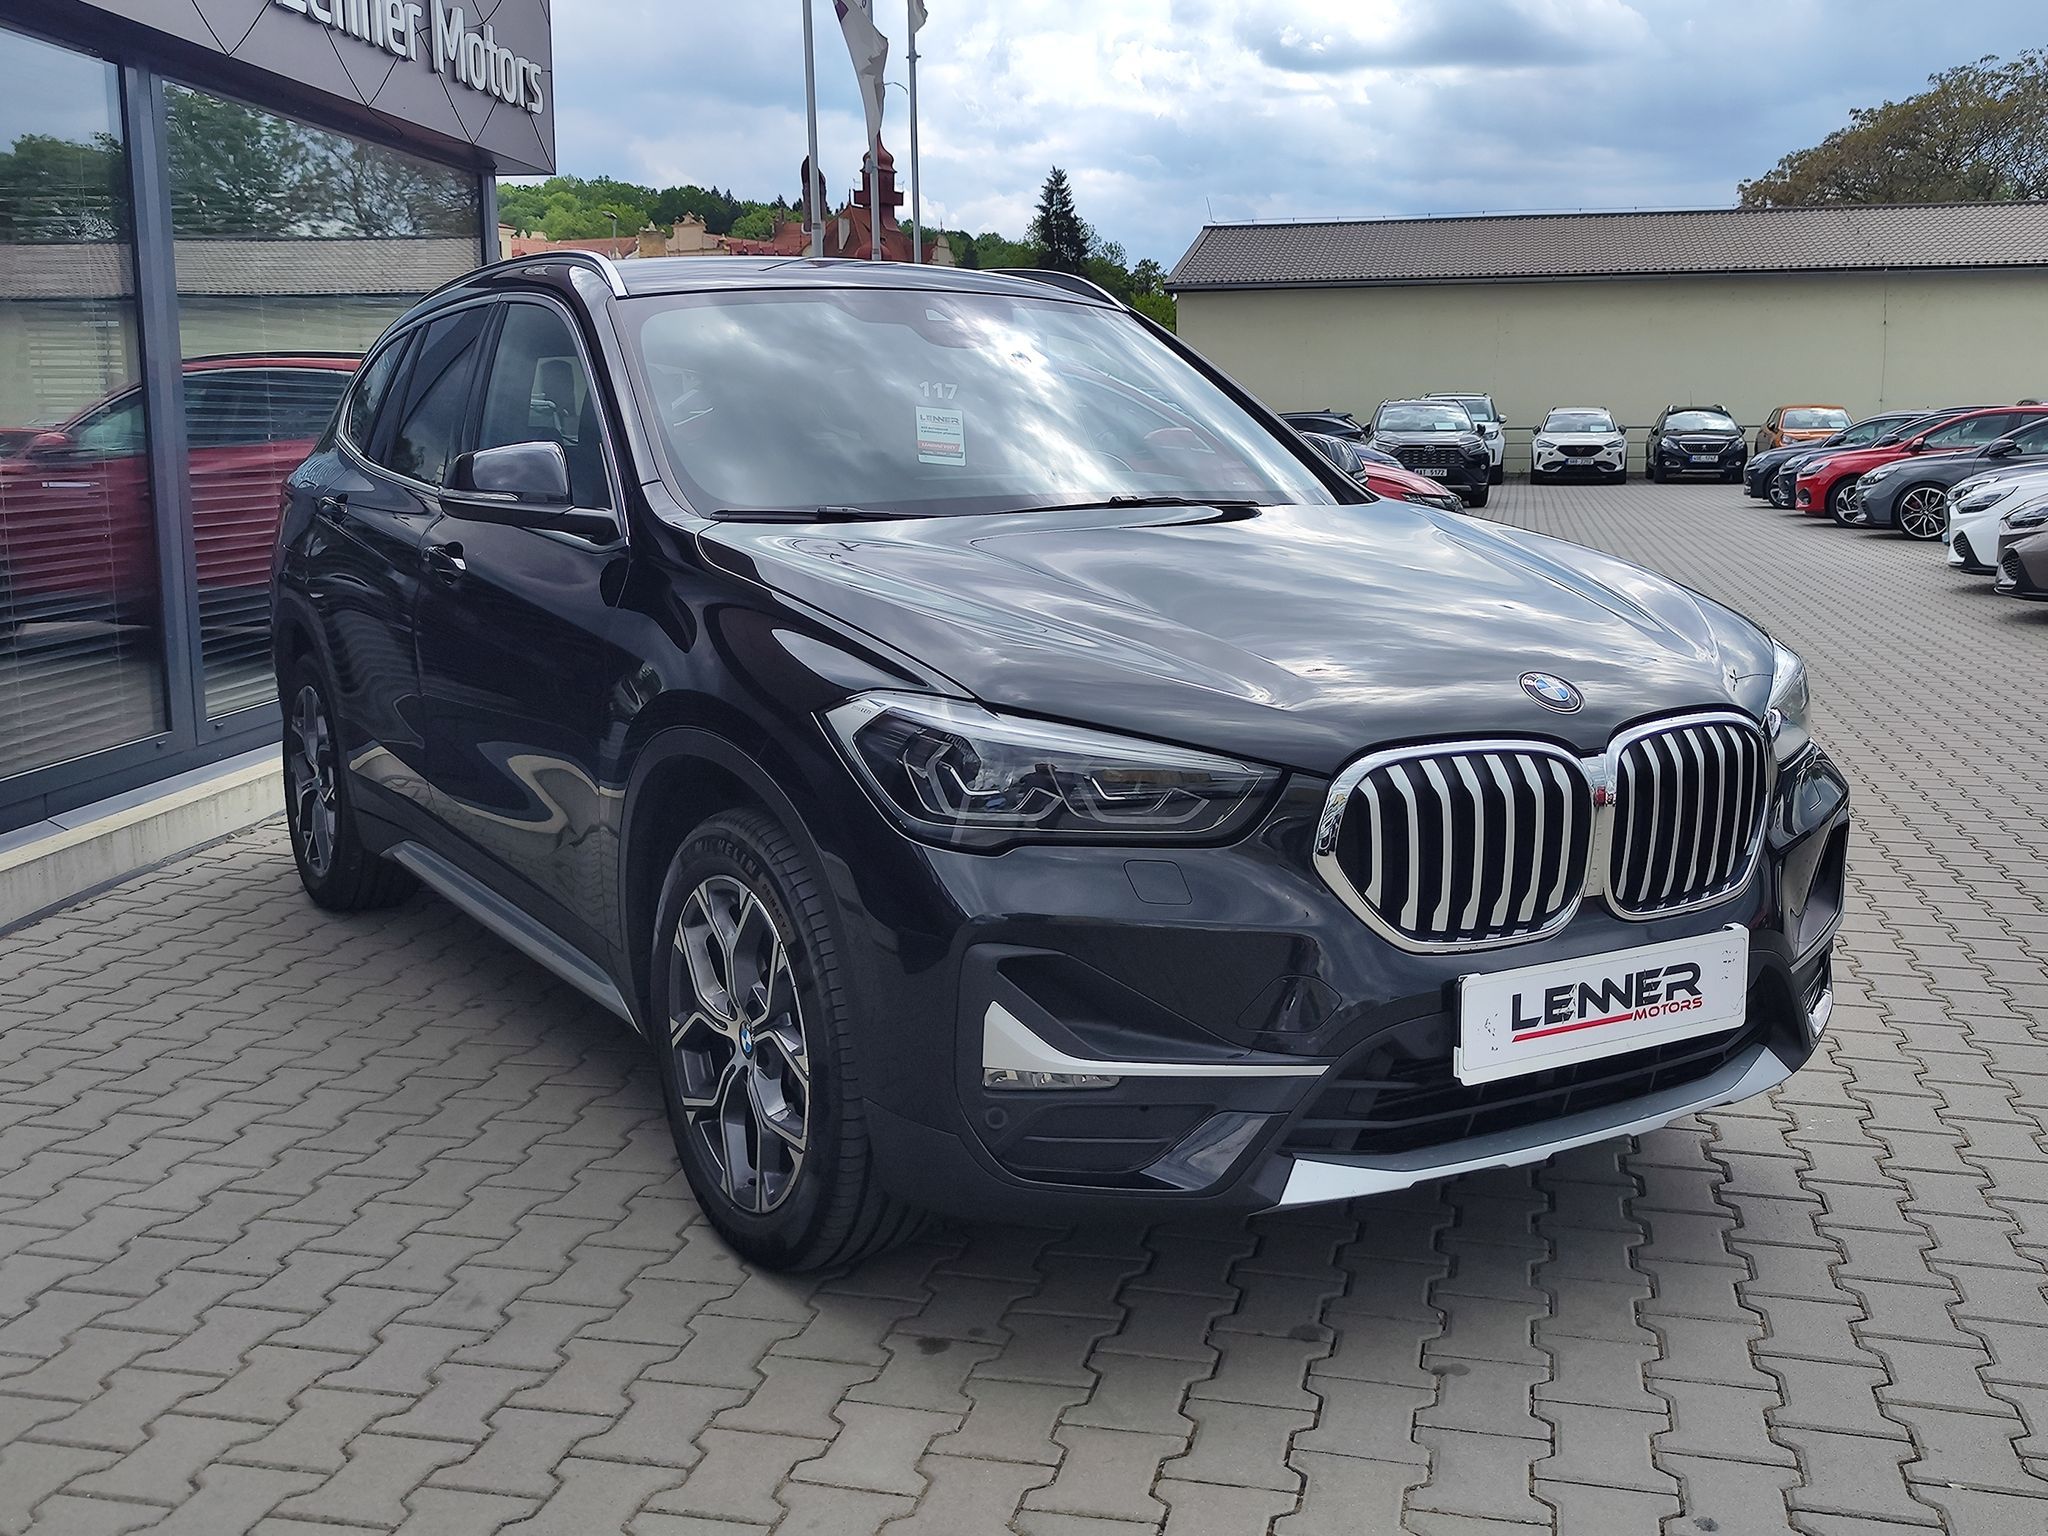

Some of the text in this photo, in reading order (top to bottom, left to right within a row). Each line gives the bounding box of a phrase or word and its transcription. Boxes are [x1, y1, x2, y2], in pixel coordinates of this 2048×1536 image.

[275, 0, 544, 115] nner Motors
[919, 381, 958, 400] 117
[694, 839, 757, 874] MIHELIN
[1511, 962, 1703, 1032] LENNER
[1632, 996, 1704, 1022] MOTORS
